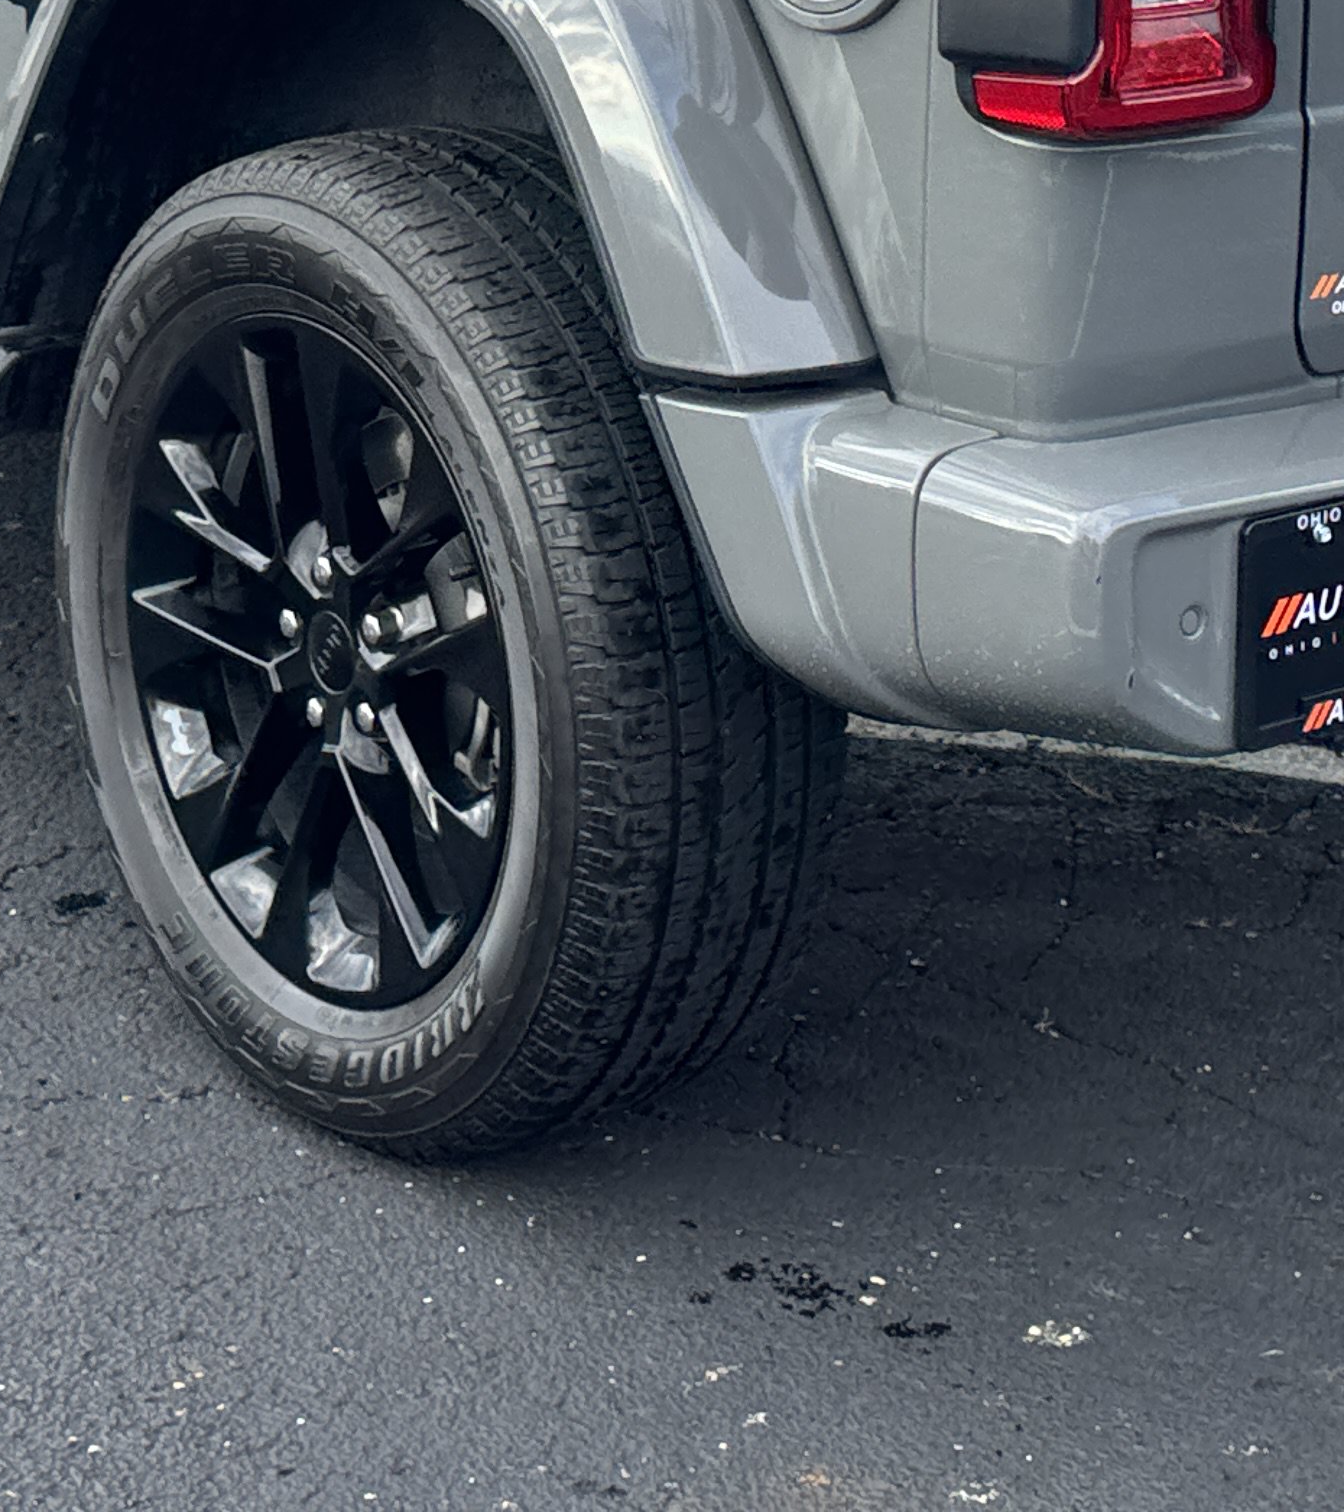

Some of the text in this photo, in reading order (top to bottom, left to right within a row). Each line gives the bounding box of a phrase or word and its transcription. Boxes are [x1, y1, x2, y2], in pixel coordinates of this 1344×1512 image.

[90, 242, 298, 423] DUELER
[1297, 506, 1341, 530] OHIO
[1268, 637, 1321, 660] OHIO
[158, 910, 485, 1089] BRIDGESTONE
